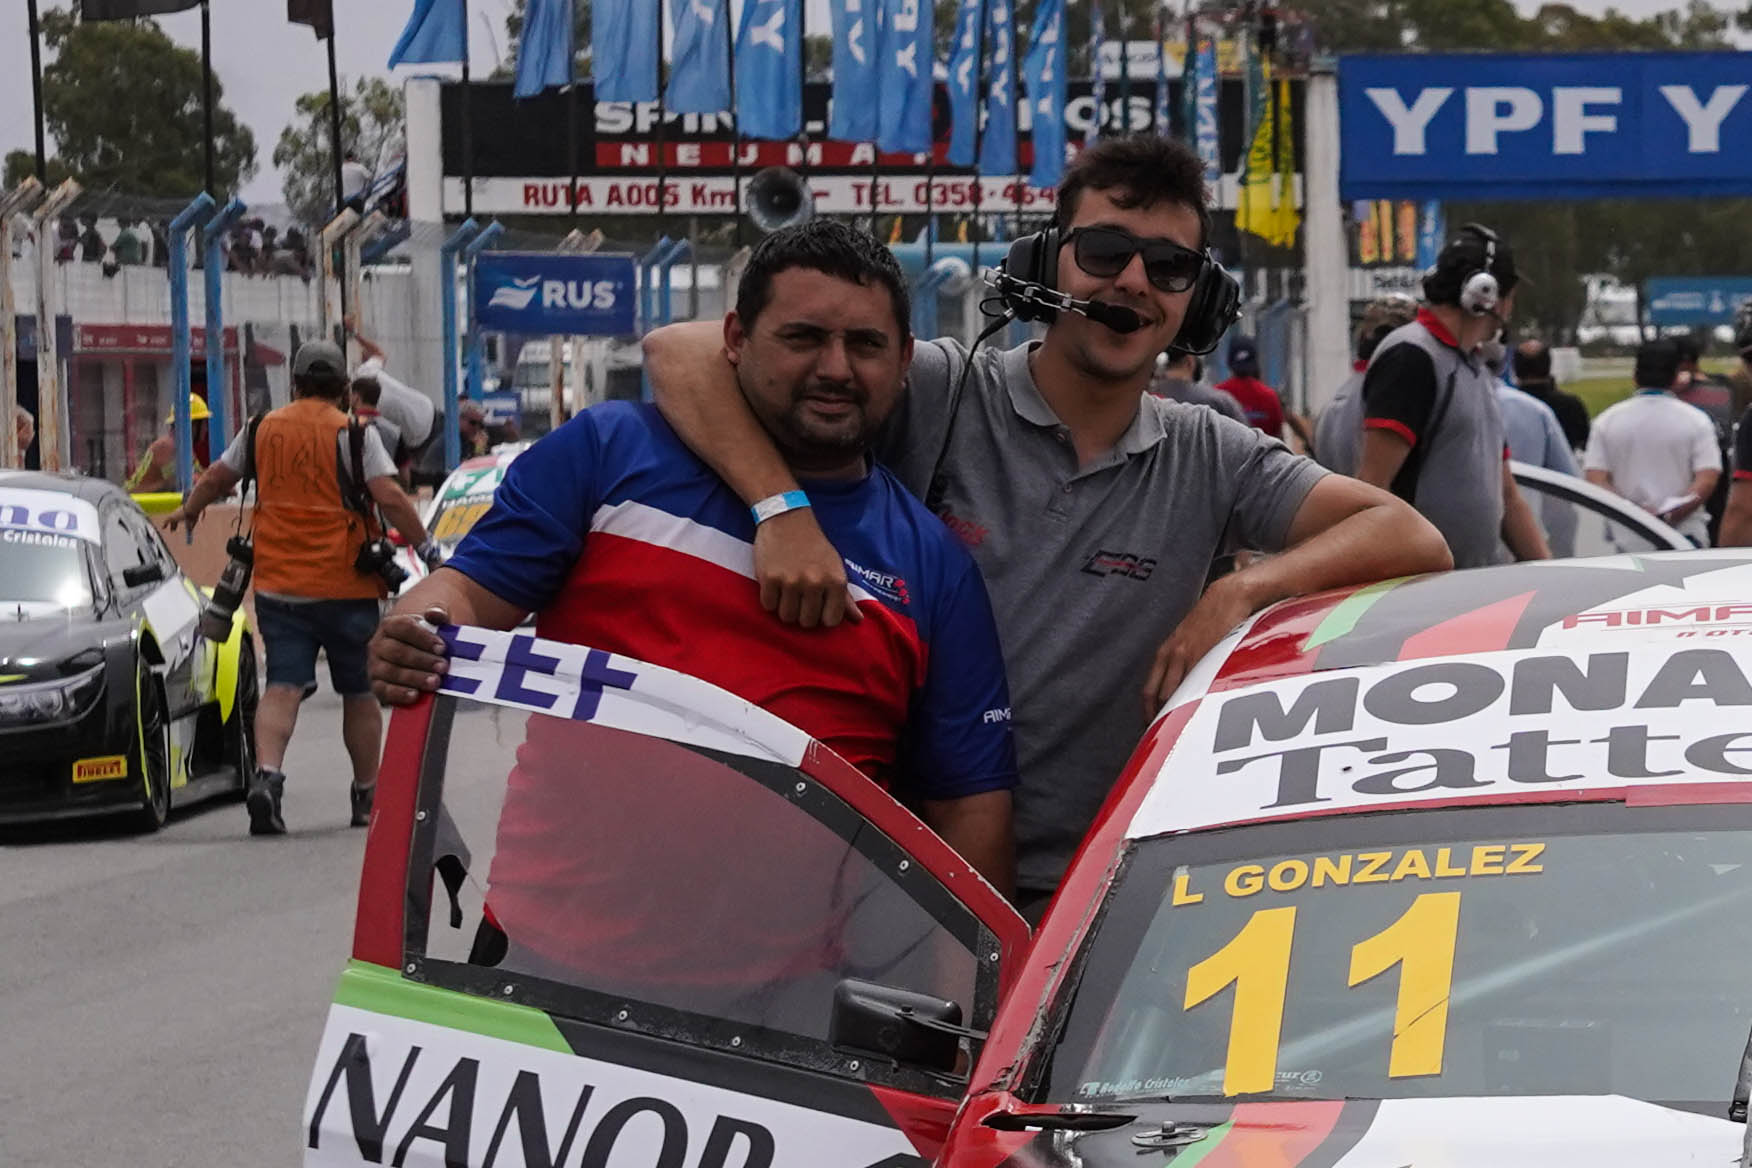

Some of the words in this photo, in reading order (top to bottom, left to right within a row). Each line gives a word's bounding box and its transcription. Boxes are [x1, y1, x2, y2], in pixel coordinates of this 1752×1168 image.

[1365, 87, 1622, 154] YPF
[523, 184, 592, 208] RUTA
[542, 280, 616, 309] RUS
[1171, 874, 1203, 907] L
[1223, 842, 1547, 898] GONZALEZ
[1182, 890, 1463, 1099] 11
